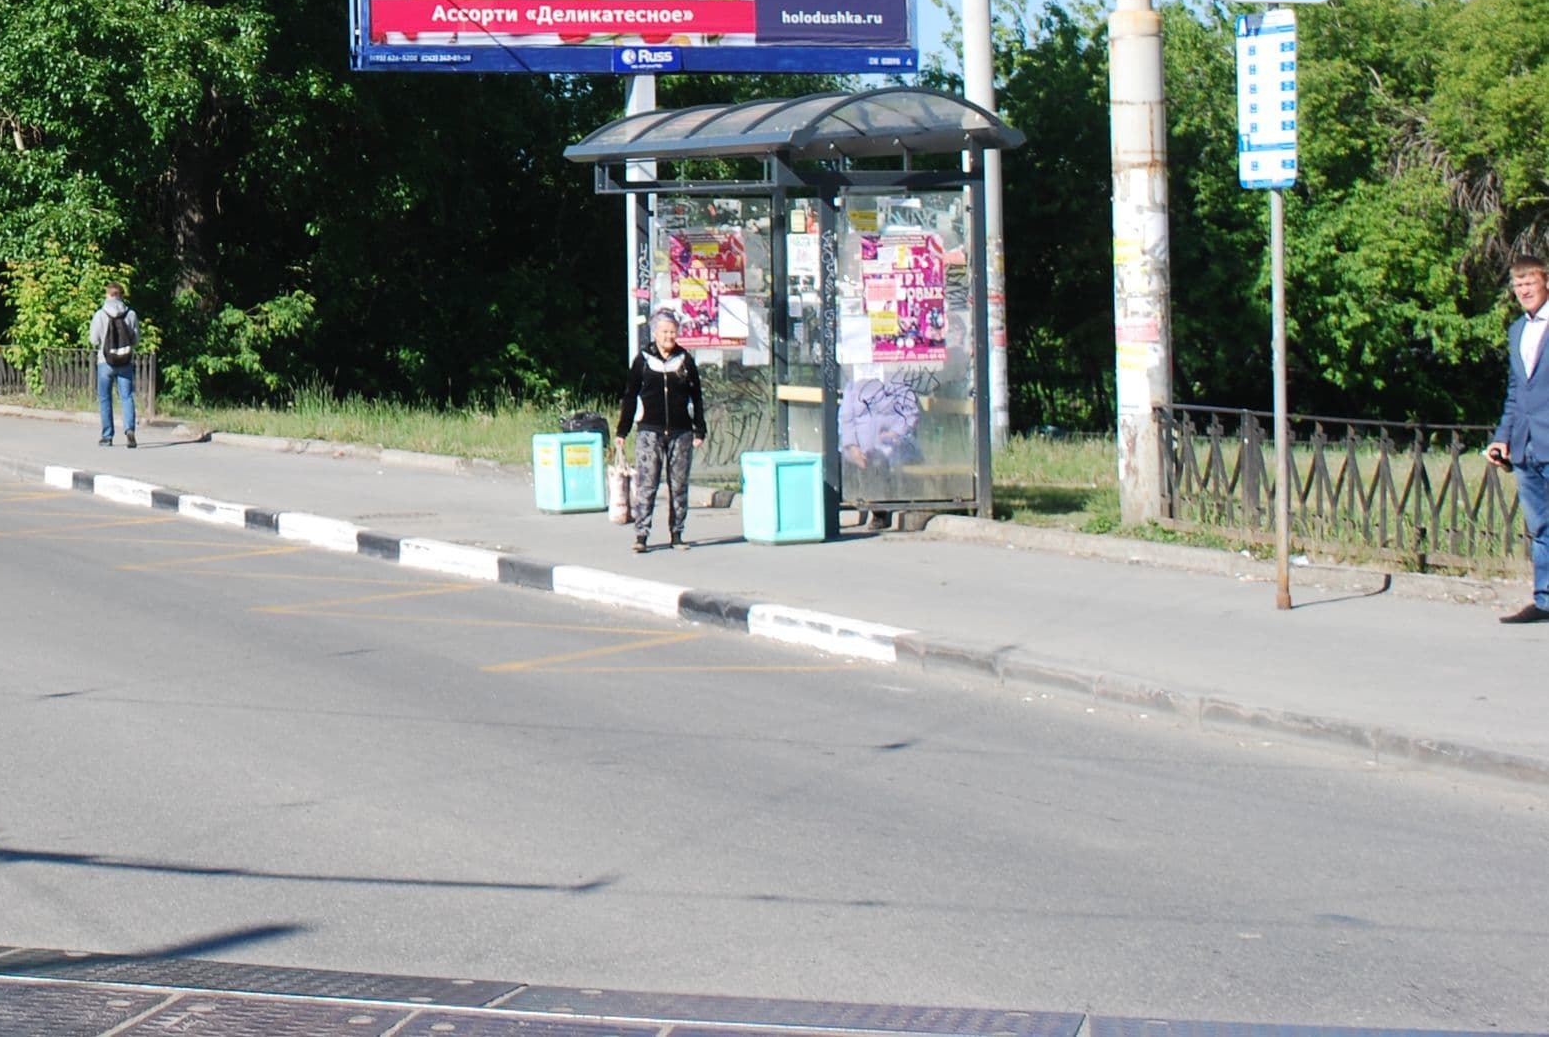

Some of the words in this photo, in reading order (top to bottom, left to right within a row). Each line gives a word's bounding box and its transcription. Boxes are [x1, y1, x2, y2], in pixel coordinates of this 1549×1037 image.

[431, 5, 518, 24] Ассорти
[526, 5, 694, 24] «Деликатесное»
[782, 11, 883, 24] holodushka.ru
[638, 49, 673, 63] Russ
